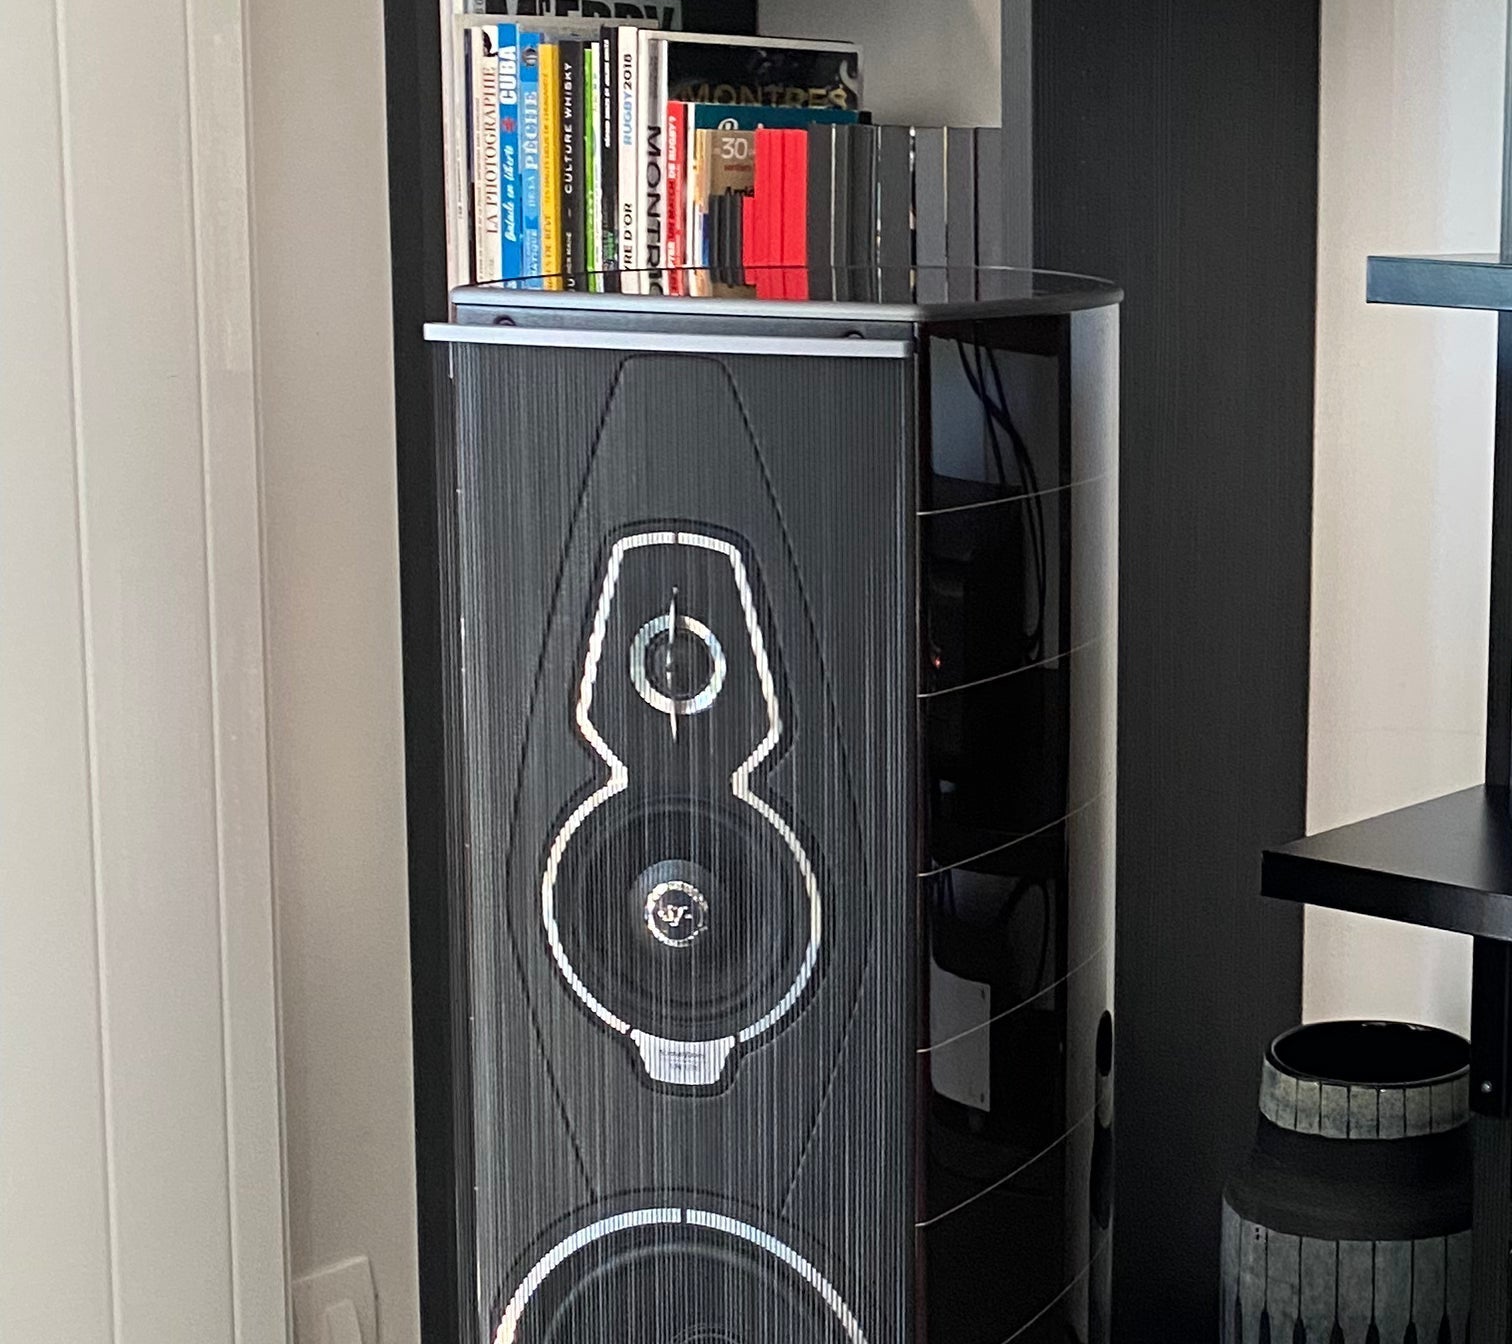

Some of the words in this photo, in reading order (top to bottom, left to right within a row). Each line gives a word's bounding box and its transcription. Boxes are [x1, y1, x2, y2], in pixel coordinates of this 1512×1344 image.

[500, 45, 518, 105] CUBA
[564, 62, 574, 119] WHISKY
[482, 67, 498, 204] PHOTOGRAPHIE
[523, 91, 538, 170] PÊCHE
[564, 123, 574, 194] CULTURE
[721, 138, 748, 159] 30
[486, 212, 498, 234] LA
[623, 203, 633, 238] D'OR
[646, 125, 664, 270] MONTR
